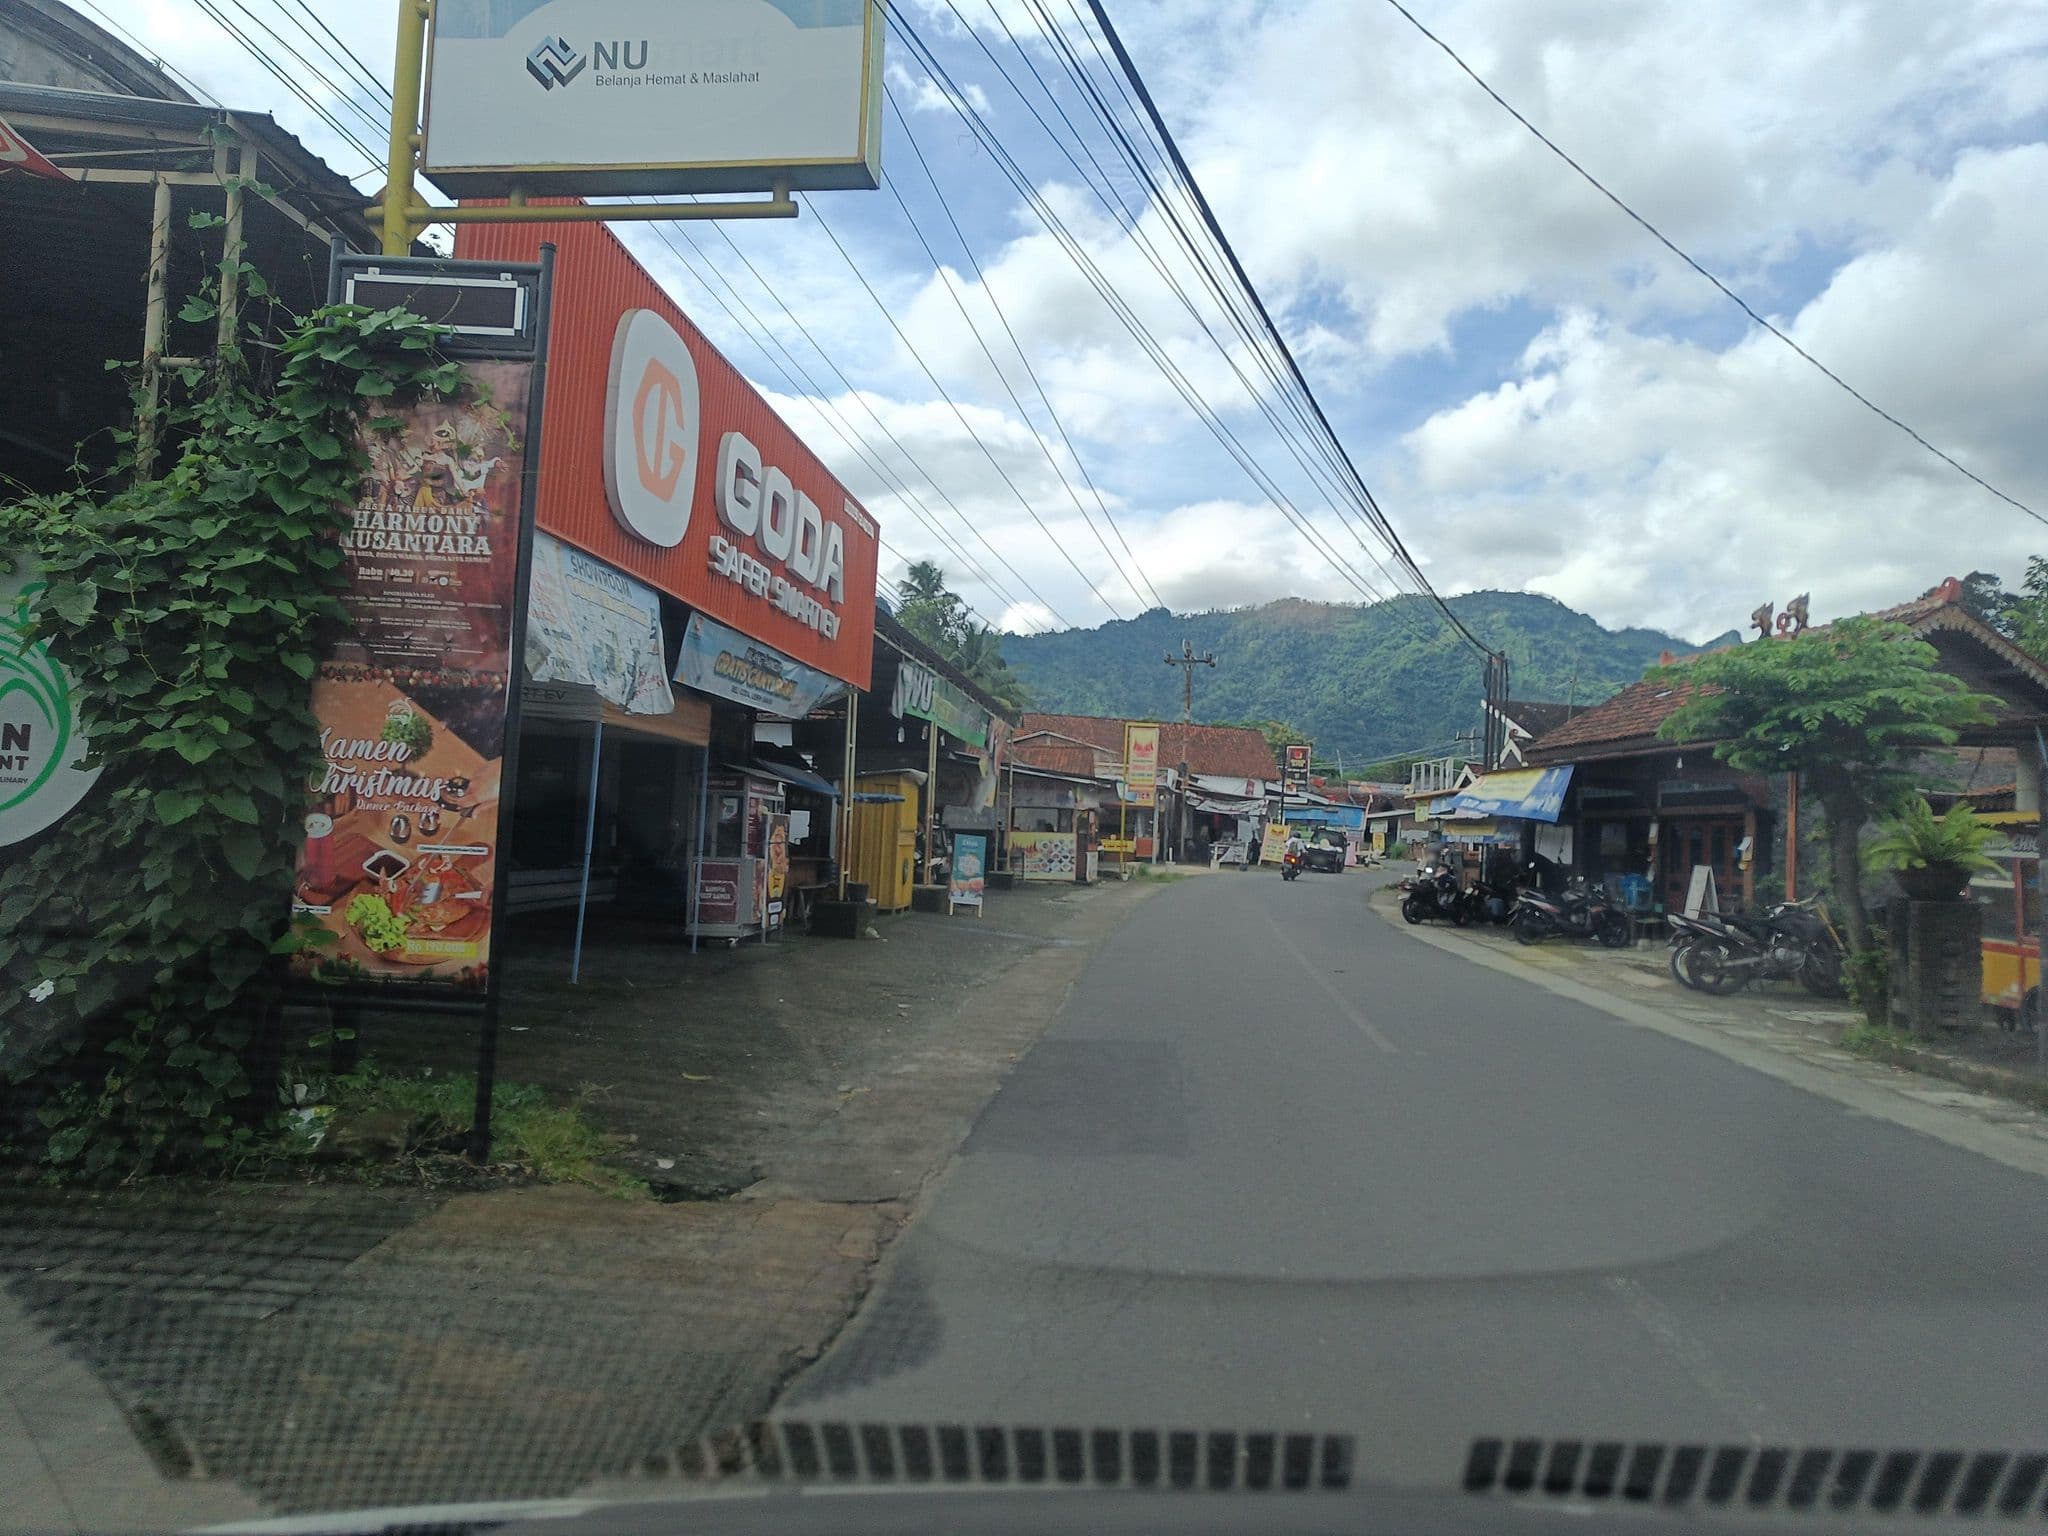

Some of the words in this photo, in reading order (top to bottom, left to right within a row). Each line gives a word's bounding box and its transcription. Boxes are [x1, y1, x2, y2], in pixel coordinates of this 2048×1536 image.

[595, 74, 641, 88] Belanja
[645, 73, 687, 86] Hemat
[689, 73, 699, 84] &
[702, 71, 760, 84] Maslahat
[353, 510, 482, 534] HARMONY
[715, 431, 845, 605] GODA
[339, 530, 491, 556] NUSANTARA
[570, 554, 633, 600] SHOWROOM
[708, 535, 771, 600] SAFER
